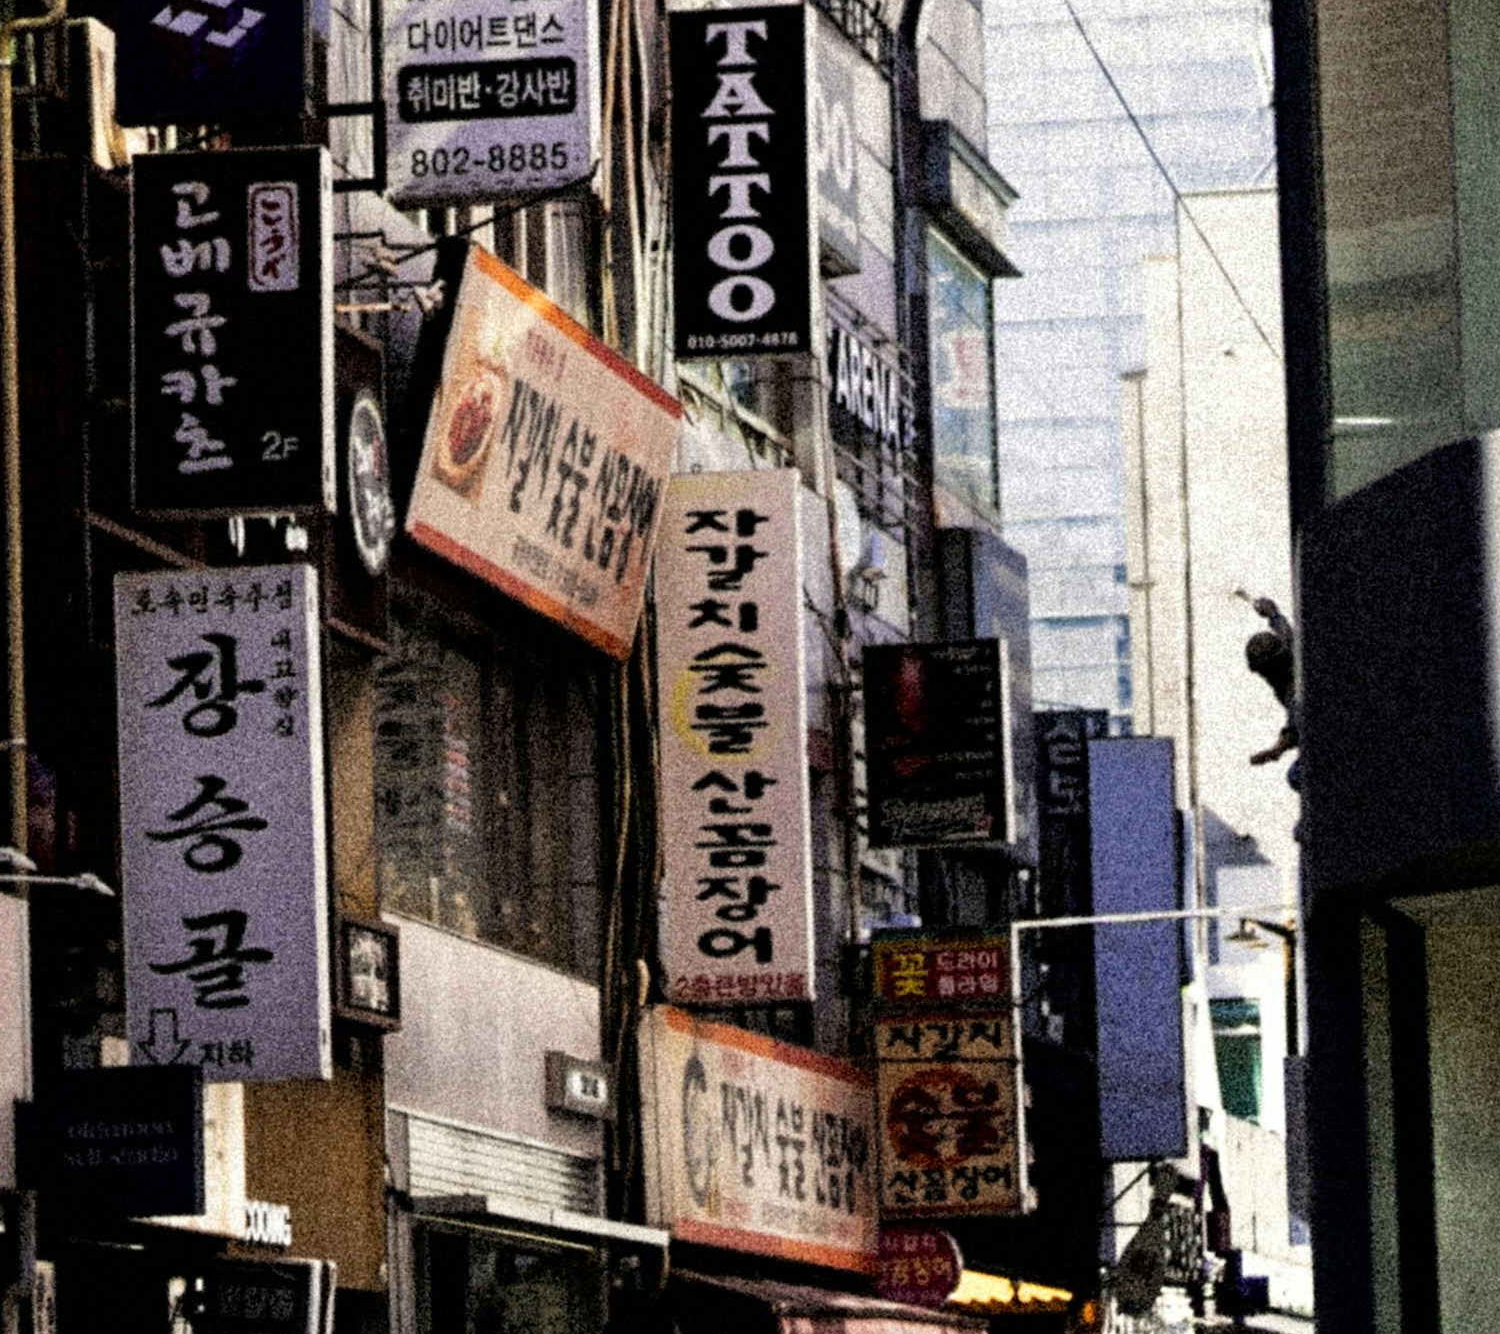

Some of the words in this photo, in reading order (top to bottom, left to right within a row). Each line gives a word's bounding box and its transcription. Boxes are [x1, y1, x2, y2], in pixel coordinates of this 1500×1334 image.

[408, 13, 565, 54] 다이어트댄스
[411, 142, 568, 177] 802-8885
[700, 20, 776, 322] TATTOO
[261, 431, 299, 460] 2F
[144, 633, 274, 1009] 장승골
[200, 1040, 254, 1068] 지하
